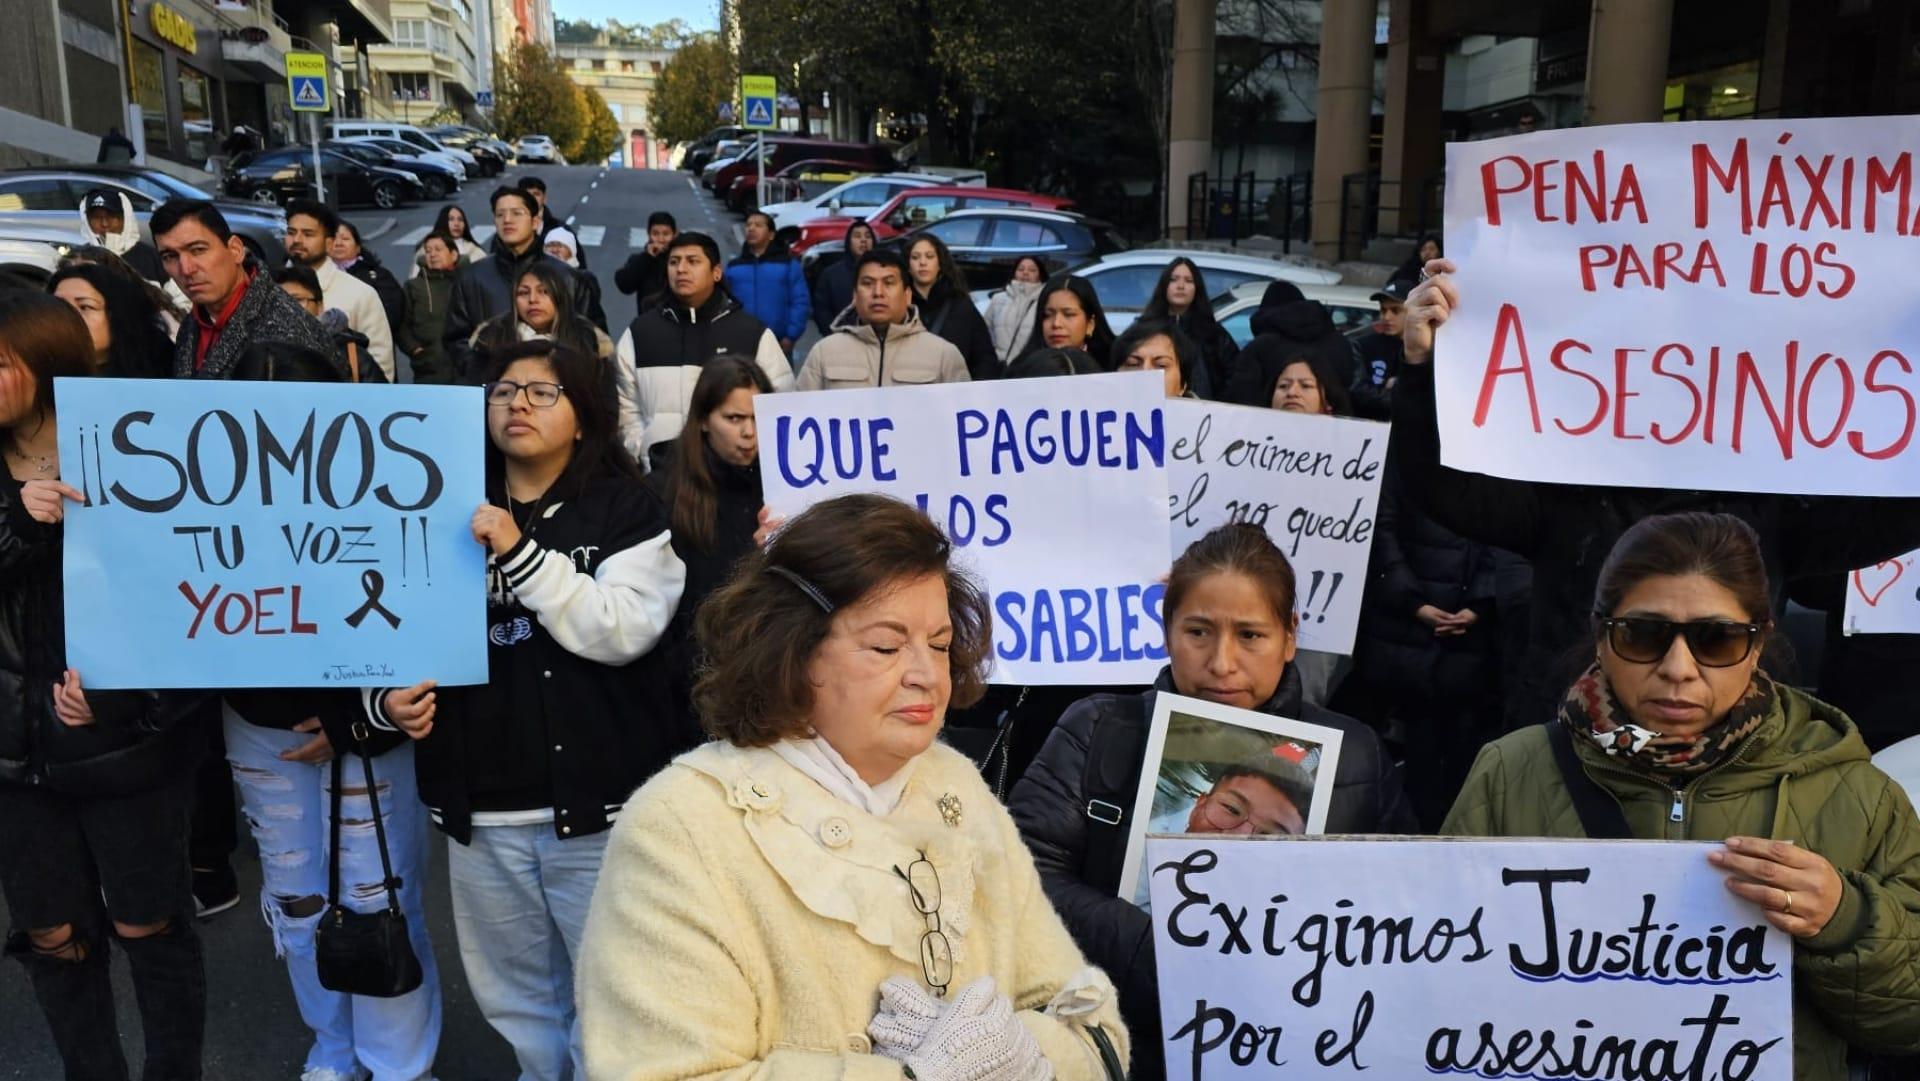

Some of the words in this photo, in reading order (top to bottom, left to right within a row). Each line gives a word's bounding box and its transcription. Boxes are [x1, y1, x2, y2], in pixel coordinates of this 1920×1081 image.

[1481, 149, 1648, 225] PENA
[1692, 132, 1920, 236] MÁXIM
[1579, 240, 1726, 292] PARA
[1750, 241, 1856, 299] LOS
[1473, 303, 1917, 460] ASESINOS
[776, 415, 897, 488] QUE
[956, 408, 1165, 476] PAGUEN
[1171, 414, 1212, 464] el
[1342, 439, 1380, 481] de
[173, 525, 244, 572] TU
[1287, 497, 1373, 557] quede
[178, 581, 318, 639] YOEL
[984, 583, 1171, 665] SABLES
[1153, 849, 1494, 1008] Exigimos
[1501, 867, 1776, 980] Justicia
[1169, 999, 1289, 1081] por
[1315, 990, 1371, 1071] el
[1425, 995, 1784, 1081] asesinato
